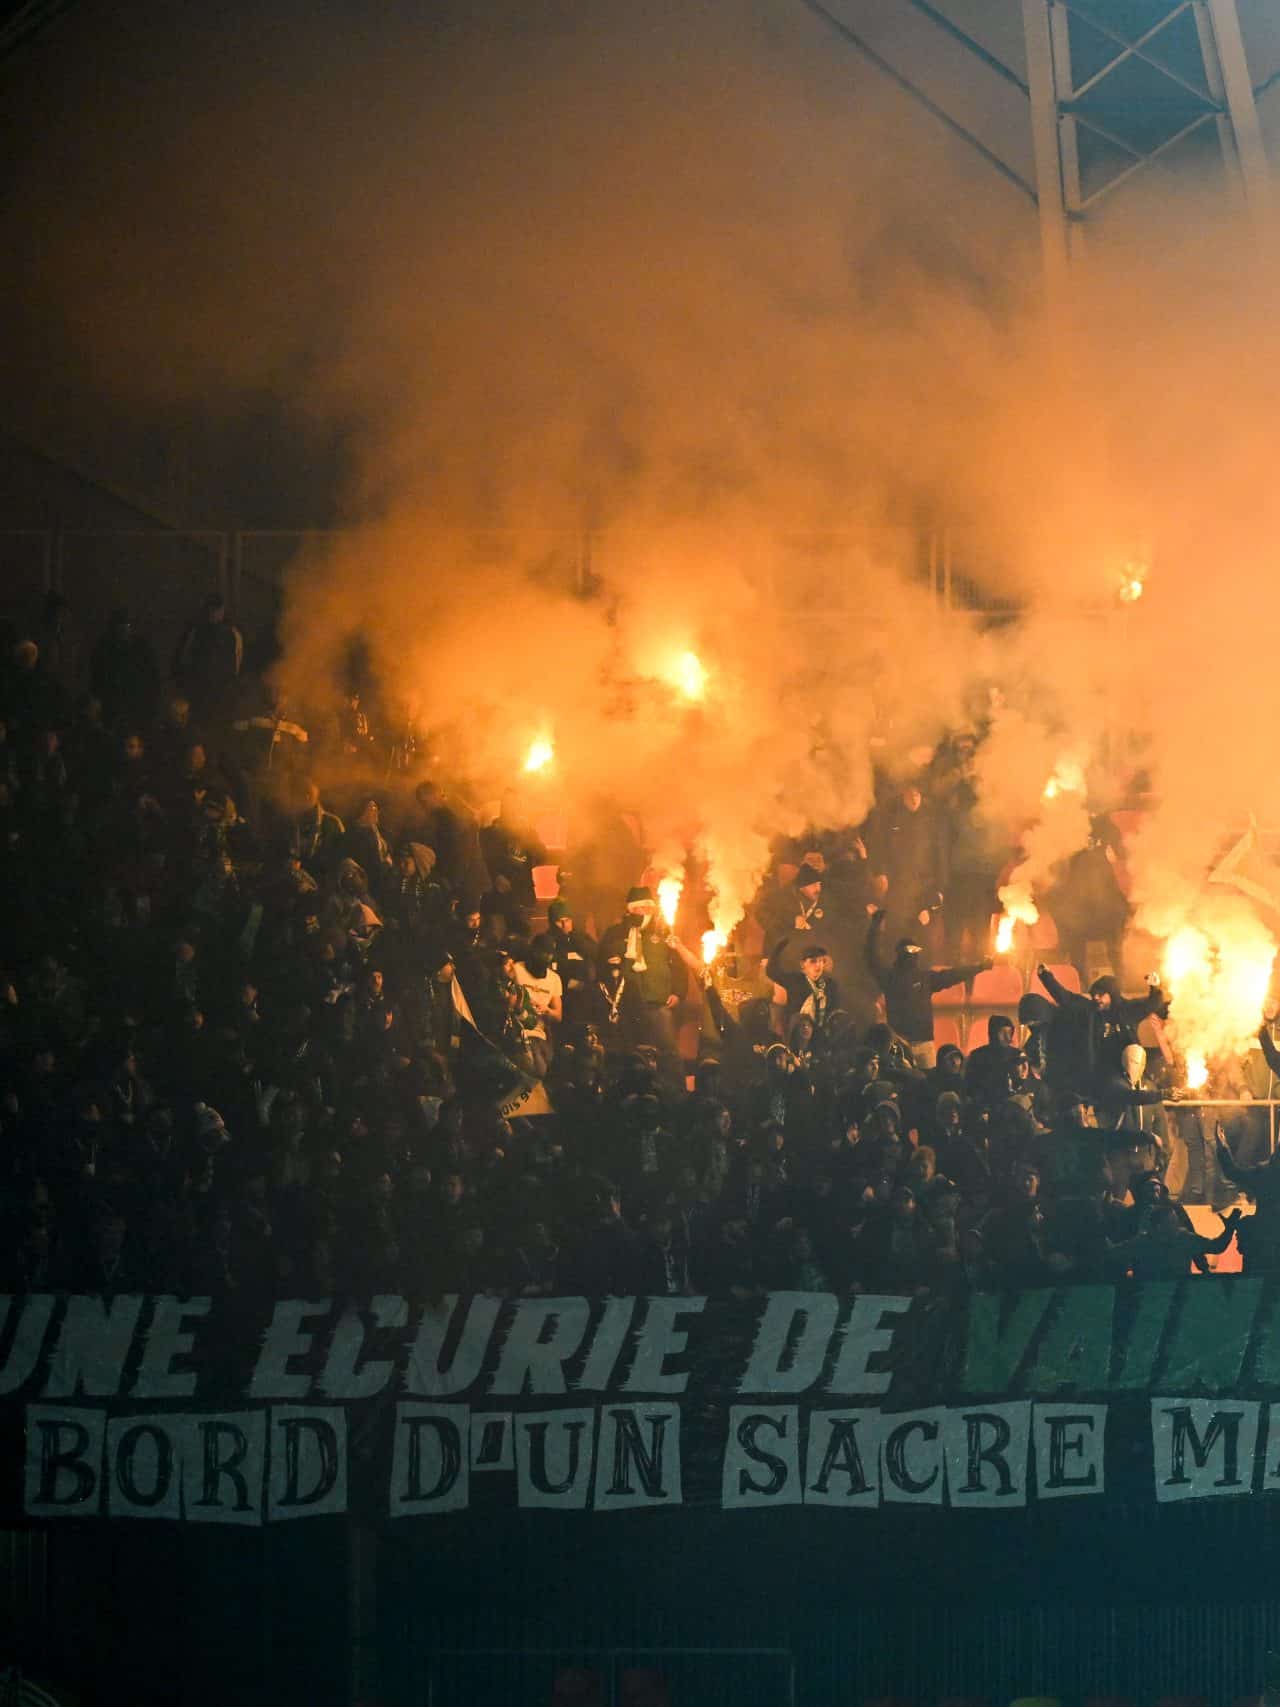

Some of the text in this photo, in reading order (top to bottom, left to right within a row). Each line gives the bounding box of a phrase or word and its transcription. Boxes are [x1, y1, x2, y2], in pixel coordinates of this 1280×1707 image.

[248, 1294, 708, 1399] ECURIE
[736, 1291, 913, 1394] DE
[31, 1417, 338, 1511] BORD
[400, 1408, 672, 1501] D'UN
[736, 1413, 1097, 1497] SACRE
